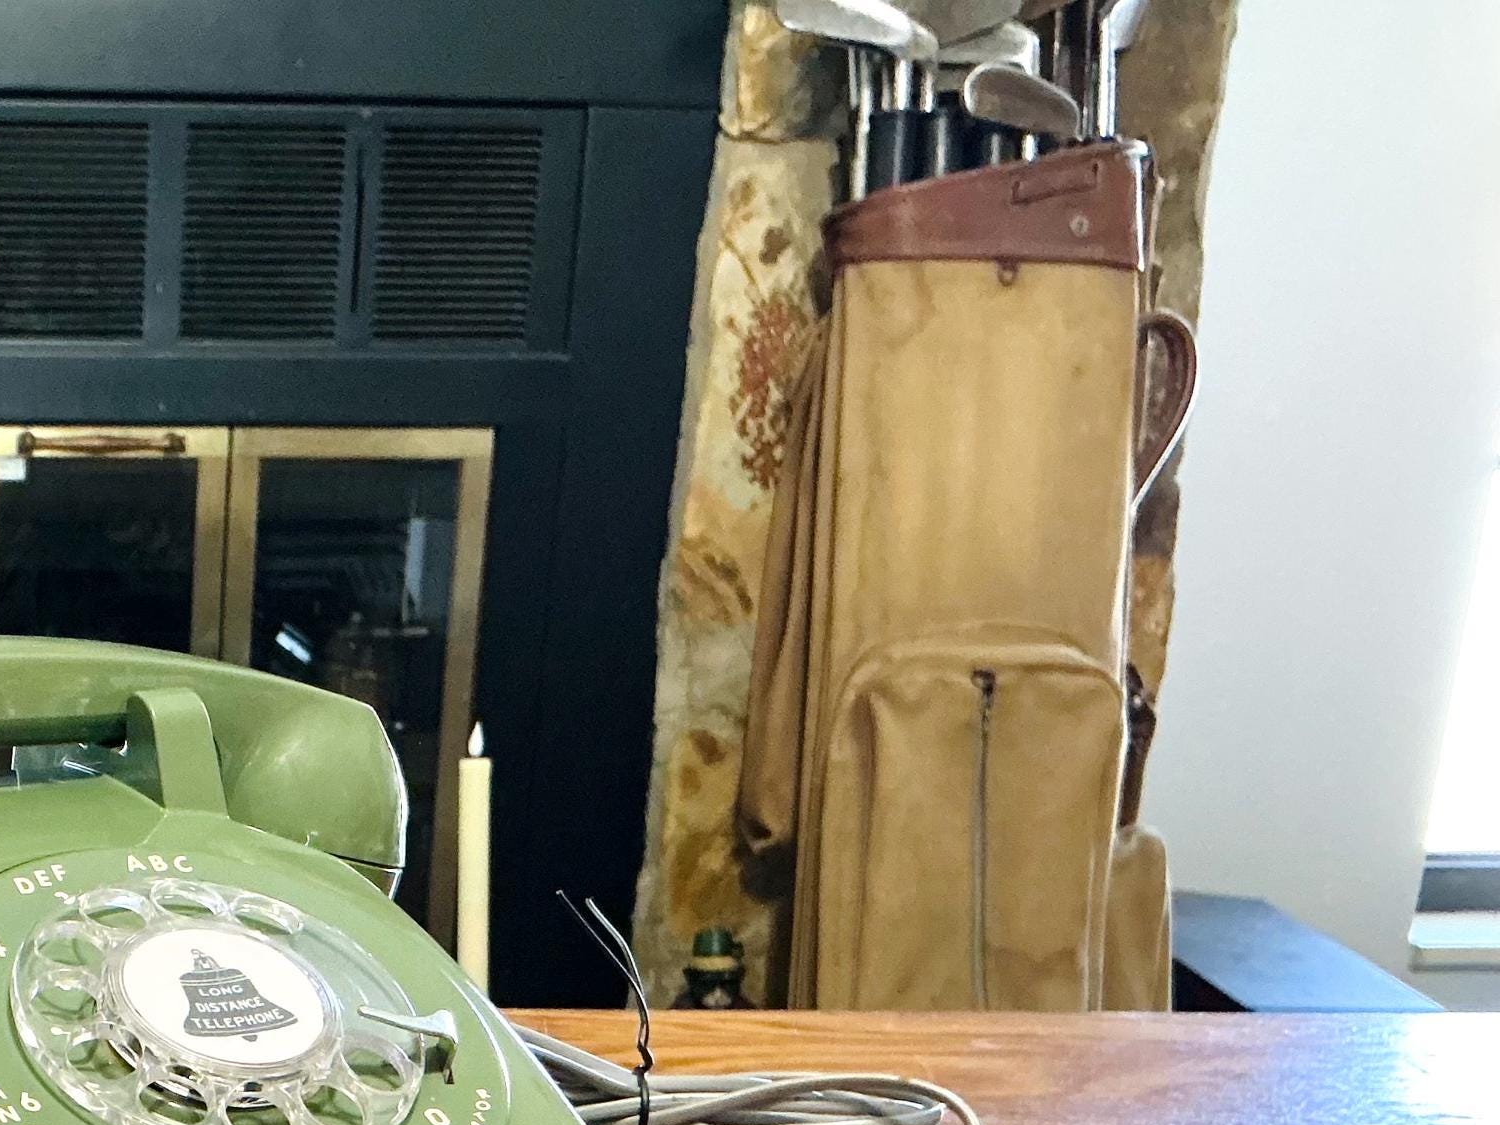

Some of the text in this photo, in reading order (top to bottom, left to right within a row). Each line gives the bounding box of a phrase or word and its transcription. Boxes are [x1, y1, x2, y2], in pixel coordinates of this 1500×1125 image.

[126, 854, 193, 873] ABC
[13, 864, 66, 894] DEF
[198, 984, 244, 997] LONG
[195, 996, 265, 1013] DISTANCE
[190, 1008, 285, 1029] TELEPHONE
[20, 1091, 42, 1112] 6
